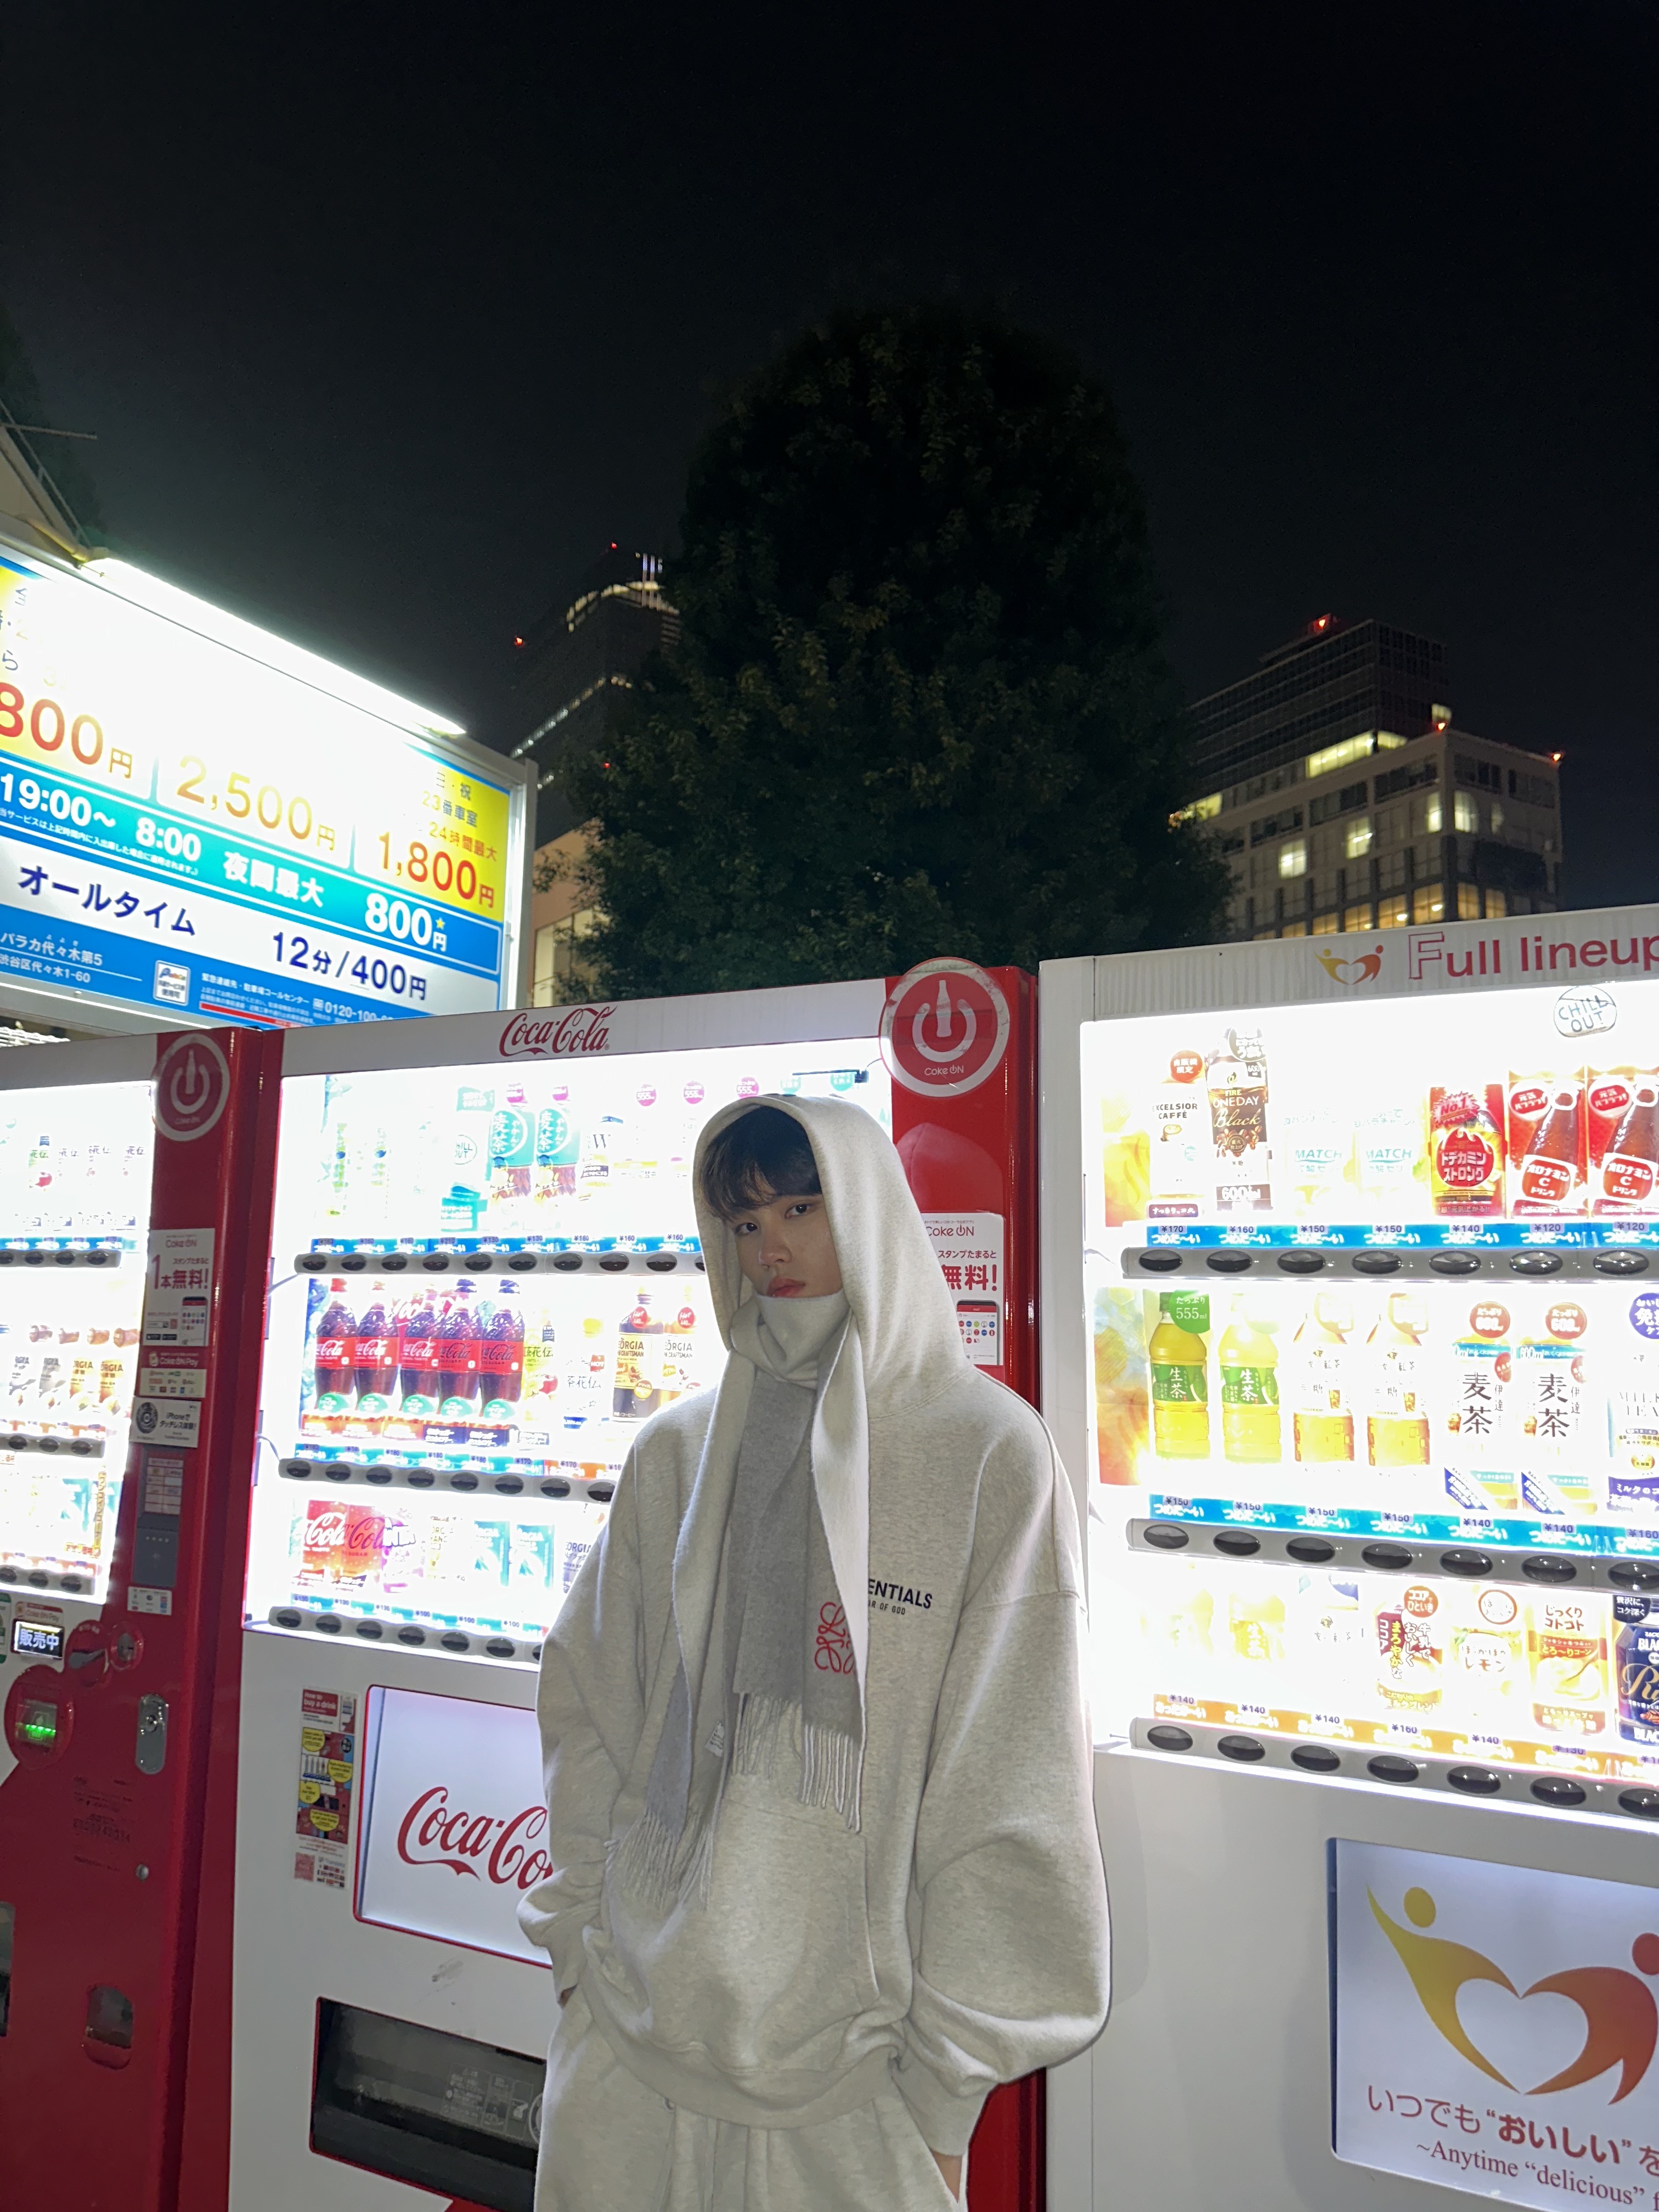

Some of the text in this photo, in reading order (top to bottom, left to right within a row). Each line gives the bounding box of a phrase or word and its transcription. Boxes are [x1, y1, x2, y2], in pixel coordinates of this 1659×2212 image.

[177, 755, 335, 851] 2,500円
[136, 817, 201, 861] 8:00
[223, 852, 324, 908] 夜間最大
[377, 831, 495, 909] 1,800円
[18, 865, 196, 936] オールタイム
[273, 932, 426, 1001] 12分/400円
[1408, 930, 1659, 980] Full lineup
[1558, 995, 1609, 1020] CHILL
[1571, 1011, 1603, 1032] OUT
[499, 1005, 618, 1057] Coca-Cola
[924, 1064, 964, 1076] Coke ON
[1158, 1110, 1188, 1120] CAFFÉ
[1213, 1108, 1262, 1128] Black
[1295, 1149, 1343, 1159] MATCH
[1441, 1152, 1486, 1166] ドデカミン
[1443, 1167, 1484, 1182] ストロング
[1527, 1164, 1570, 1181] オロナミン
[1608, 1163, 1651, 1180] オロナミン
[1539, 1178, 1550, 1187] C
[1620, 1176, 1632, 1185] C
[1531, 1187, 1555, 1197] ドリンク
[1612, 1186, 1637, 1196] ドリンク
[956, 1224, 974, 1237] ON
[1375, 1224, 1402, 1233] ¥150
[1452, 1224, 1480, 1233] ¥140
[1534, 1223, 1561, 1232] ¥120
[1617, 1222, 1645, 1231] ¥120
[938, 1250, 997, 1259] スタンプたまると
[151, 1254, 209, 1290] 1本無料!
[1170, 1367, 1187, 1398] 生茶
[1240, 1368, 1259, 1401] 生茶
[1462, 1372, 1493, 1434] 麦茶
[1538, 1373, 1571, 1437] 麦茶
[1165, 1497, 1189, 1506] ¥150
[1236, 1502, 1261, 1511] ¥150
[1308, 1506, 1335, 1516] ¥150
[1383, 1513, 1410, 1522] ¥150
[1463, 1518, 1491, 1528] ¥140
[1544, 1523, 1574, 1533] ¥140
[868, 1578, 933, 1609] ENTIALS
[879, 1602, 906, 1615] OF GOD
[1544, 1603, 1583, 1618] じっくり
[1617, 1607, 1645, 1616] コク深く
[1544, 1618, 1585, 1632] コトコト
[19, 1628, 60, 1651] 販売中
[1379, 1619, 1389, 1650] ココア
[1417, 1623, 1431, 1660] 牛乳で
[1390, 1621, 1404, 1679] まろやかな
[1404, 1621, 1418, 1667] おいしく
[1465, 1656, 1506, 1672] レモン
[1170, 1694, 1195, 1705] ¥140
[1242, 1704, 1266, 1714] ¥140
[1315, 1714, 1340, 1725] ¥140
[1391, 1724, 1418, 1734] ¥160
[1471, 1734, 1499, 1745] ¥140
